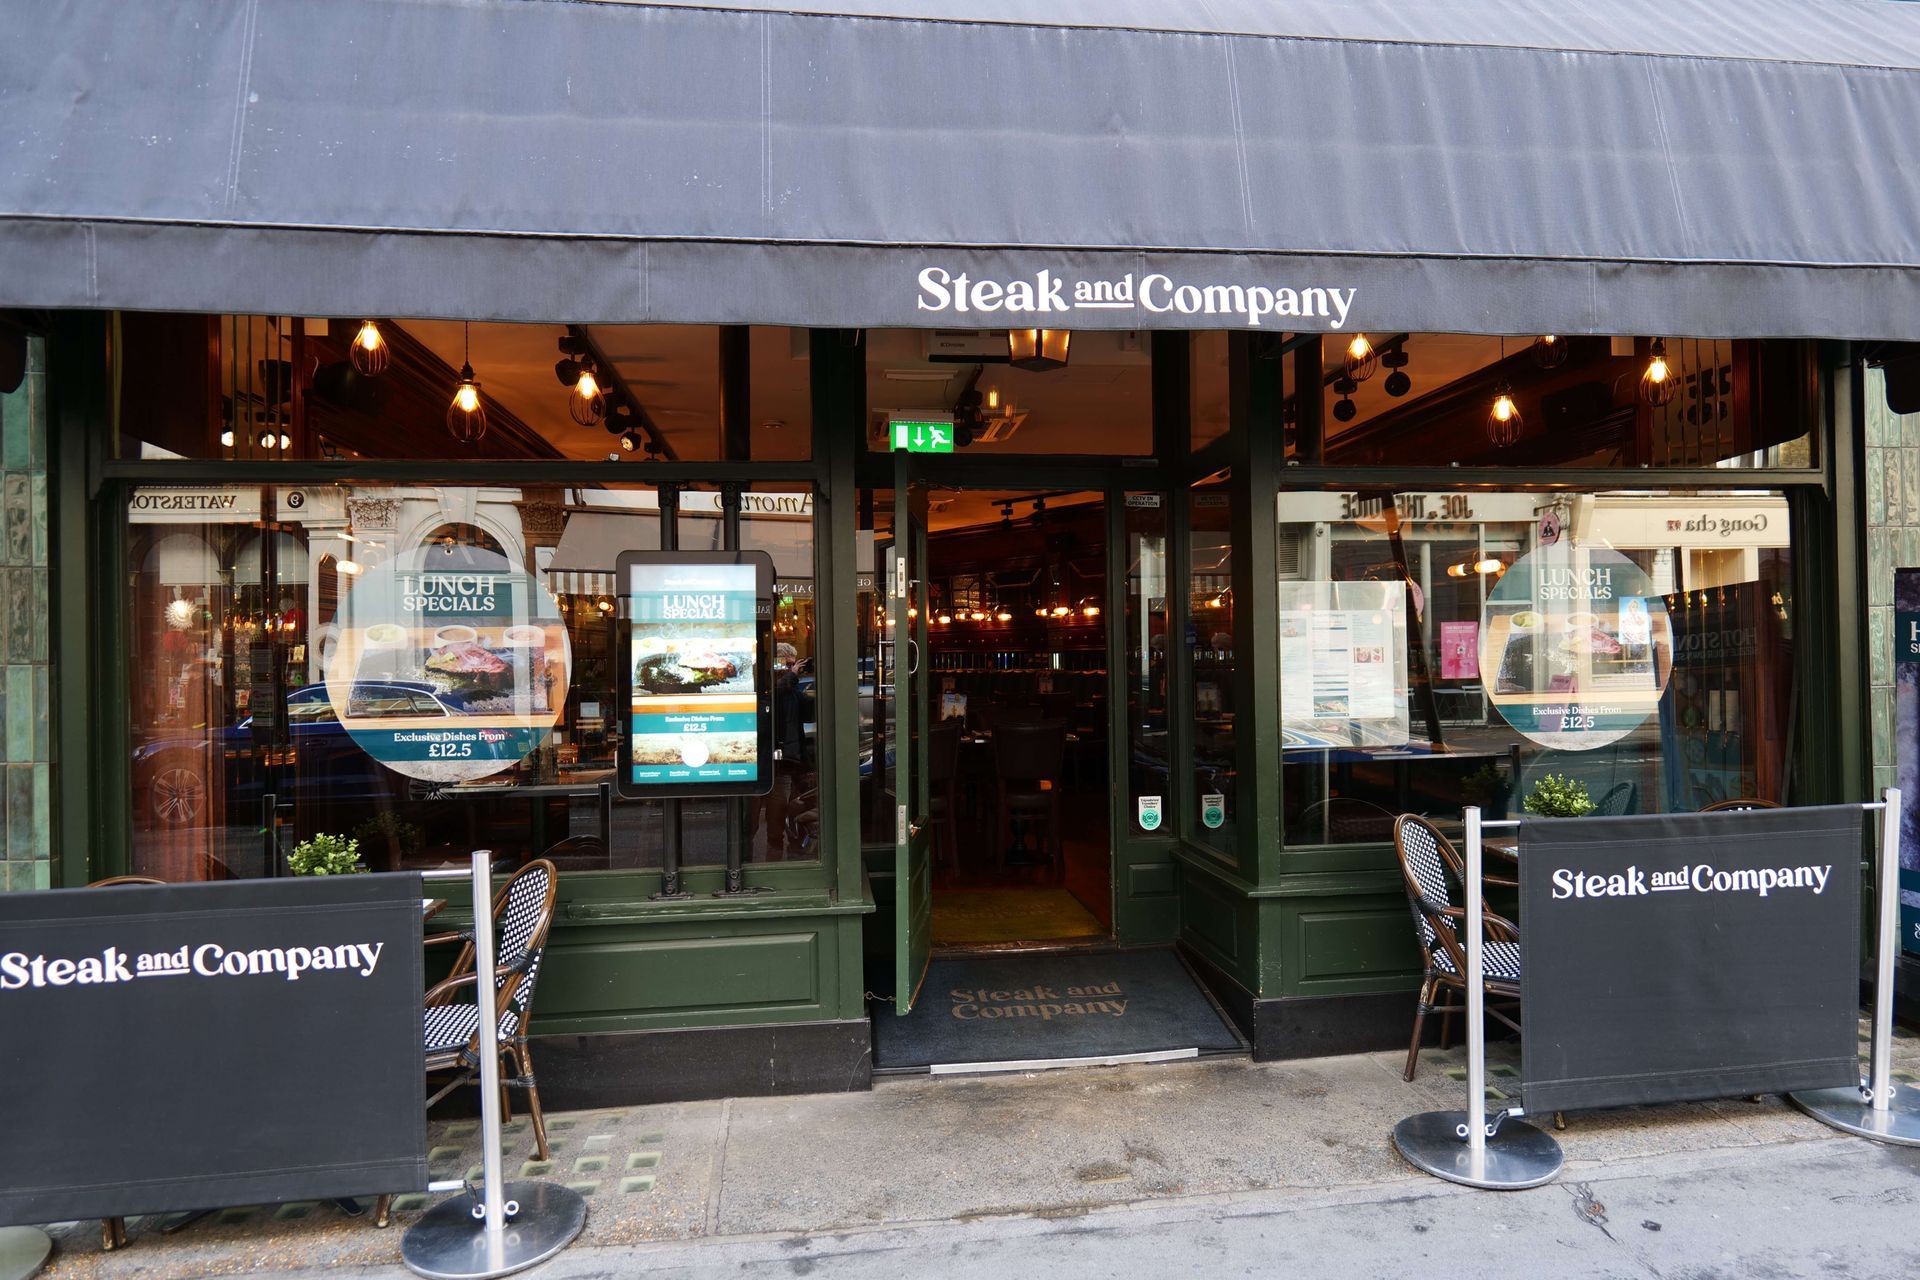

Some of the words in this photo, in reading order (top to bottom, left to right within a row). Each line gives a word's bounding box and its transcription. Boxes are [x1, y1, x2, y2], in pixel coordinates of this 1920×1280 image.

[918, 267, 1070, 312] Steak
[1074, 273, 1135, 305] and
[1139, 274, 1357, 330] Company
[1539, 568, 1612, 586] LUNCH
[403, 575, 495, 596] LUNCH
[1540, 586, 1612, 600] SPECIALS
[403, 596, 496, 612] SPECIALS
[663, 594, 725, 609] LUNCH
[663, 608, 725, 619] SPECIALS
[1532, 707, 1571, 716] Exclusive
[1572, 706, 1599, 715] Dishes
[1600, 706, 1622, 714] From
[683, 723, 707, 732] £12.5
[1560, 716, 1595, 729] £12.5
[394, 733, 442, 742] Exclusive
[443, 732, 477, 742] Dishes
[479, 731, 505, 741] From
[428, 743, 472, 758] £12.5
[1552, 866, 1649, 899] Steak
[1651, 866, 1690, 889] and
[1692, 864, 1832, 897] Company
[0, 947, 134, 990] Steak
[137, 945, 190, 975] and
[193, 943, 384, 981] Company
[950, 984, 1062, 1004] Steak
[1067, 981, 1122, 997] and
[951, 999, 1129, 1021] Company
